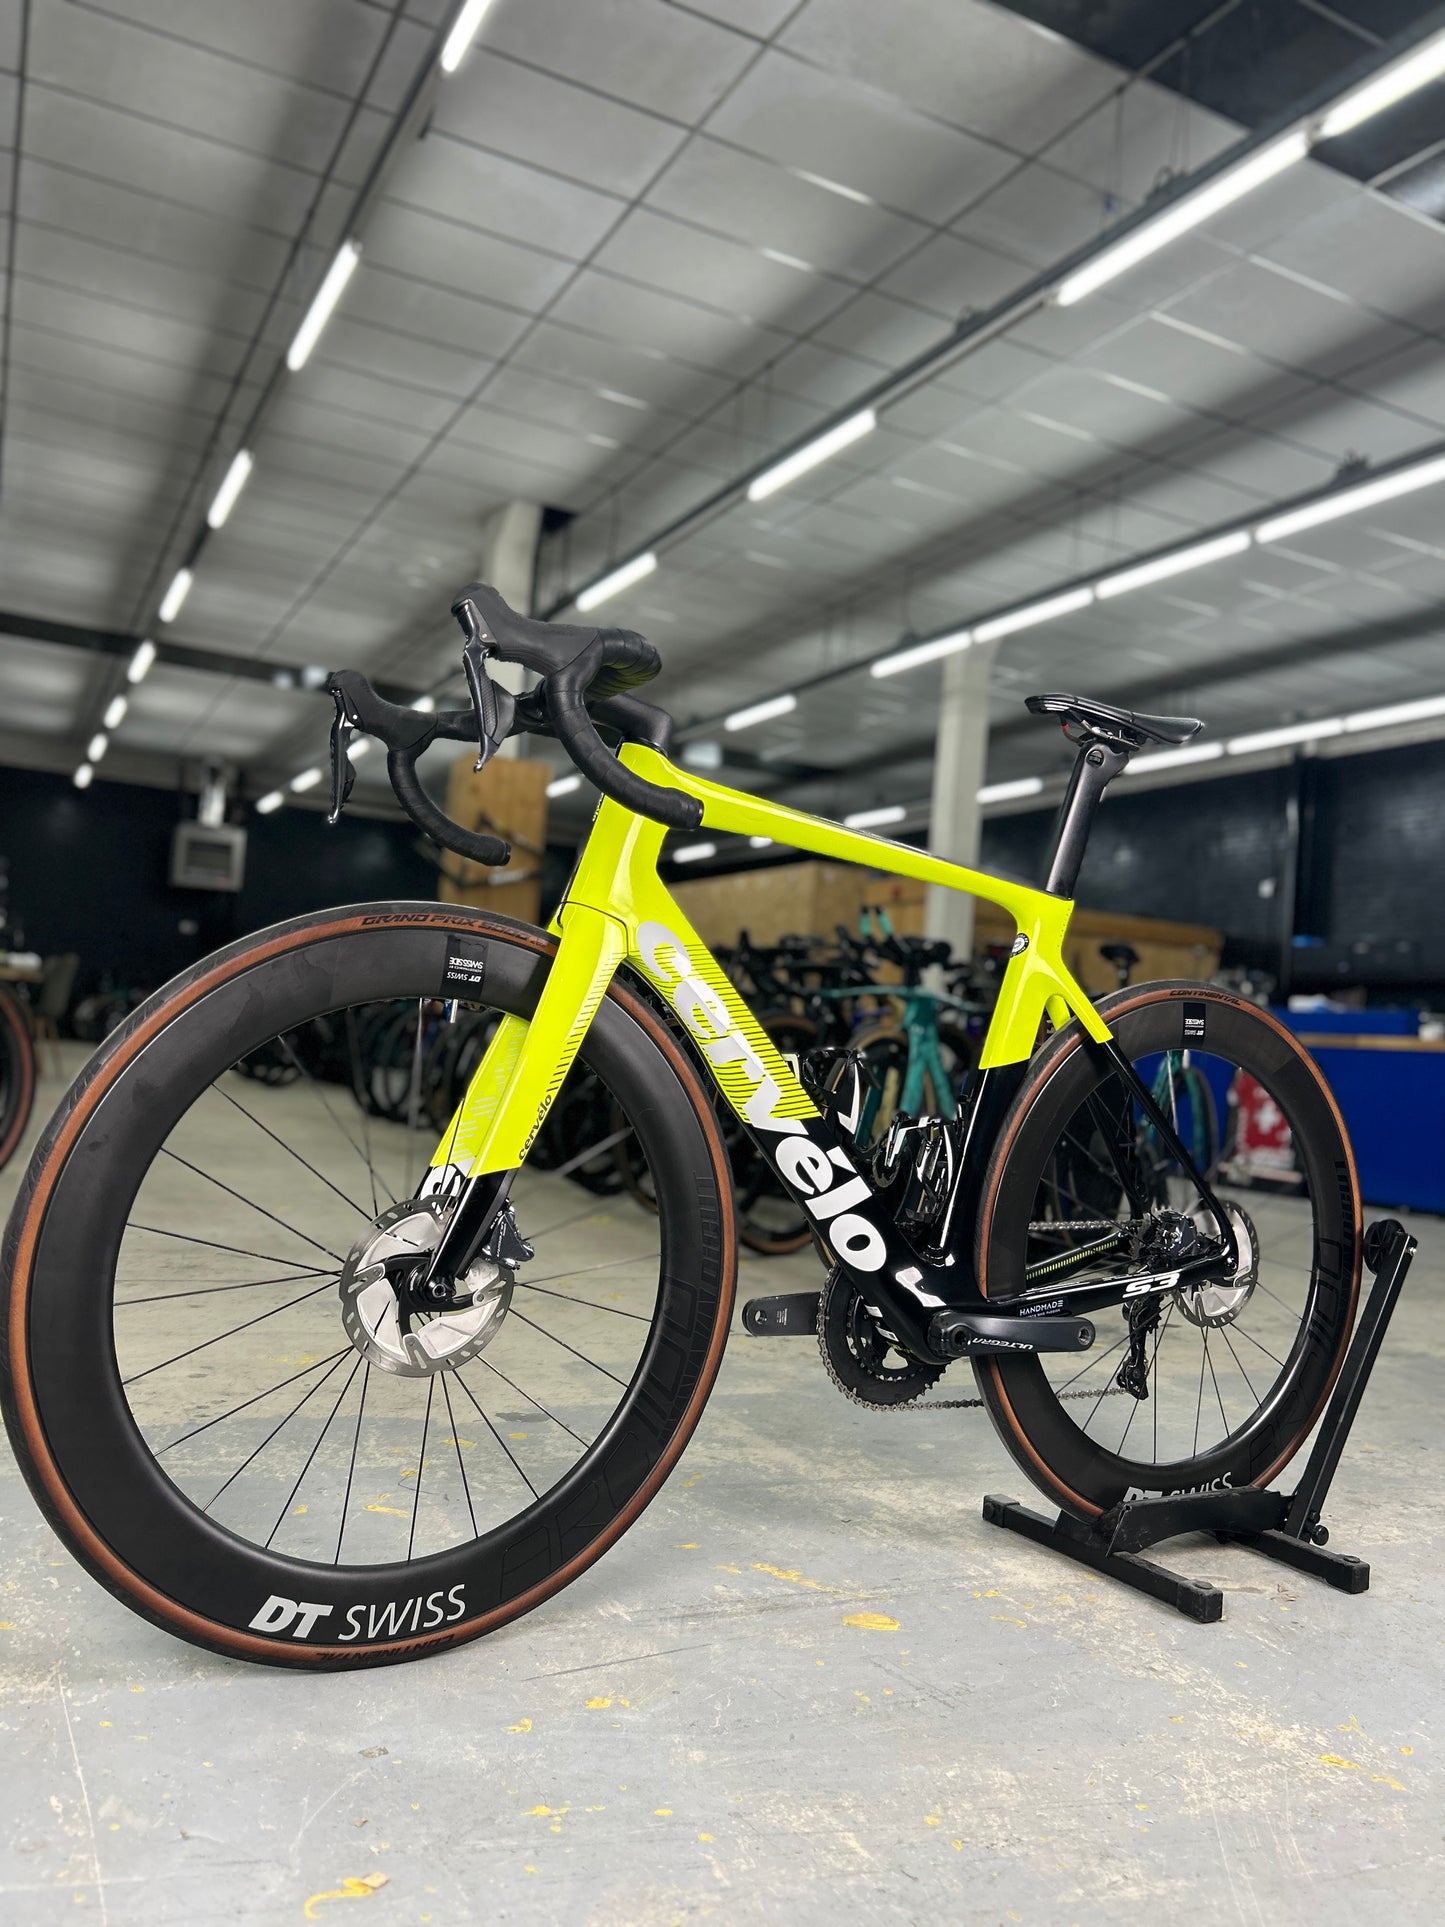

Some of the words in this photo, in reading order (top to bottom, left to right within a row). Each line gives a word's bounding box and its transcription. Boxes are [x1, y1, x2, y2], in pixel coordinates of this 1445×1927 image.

[361, 913, 427, 926] GRAND
[430, 914, 480, 928] PRIX
[446, 971, 469, 981] SWISS
[468, 975, 482, 983] DT
[1169, 989, 1241, 1006] CONTINENTAL
[1122, 1271, 1181, 1299] S3
[1019, 1299, 1064, 1317] HANDMADE
[971, 1337, 1034, 1350] ULTEGRA
[248, 1594, 334, 1639] DT
[337, 1583, 467, 1641] SWISS
